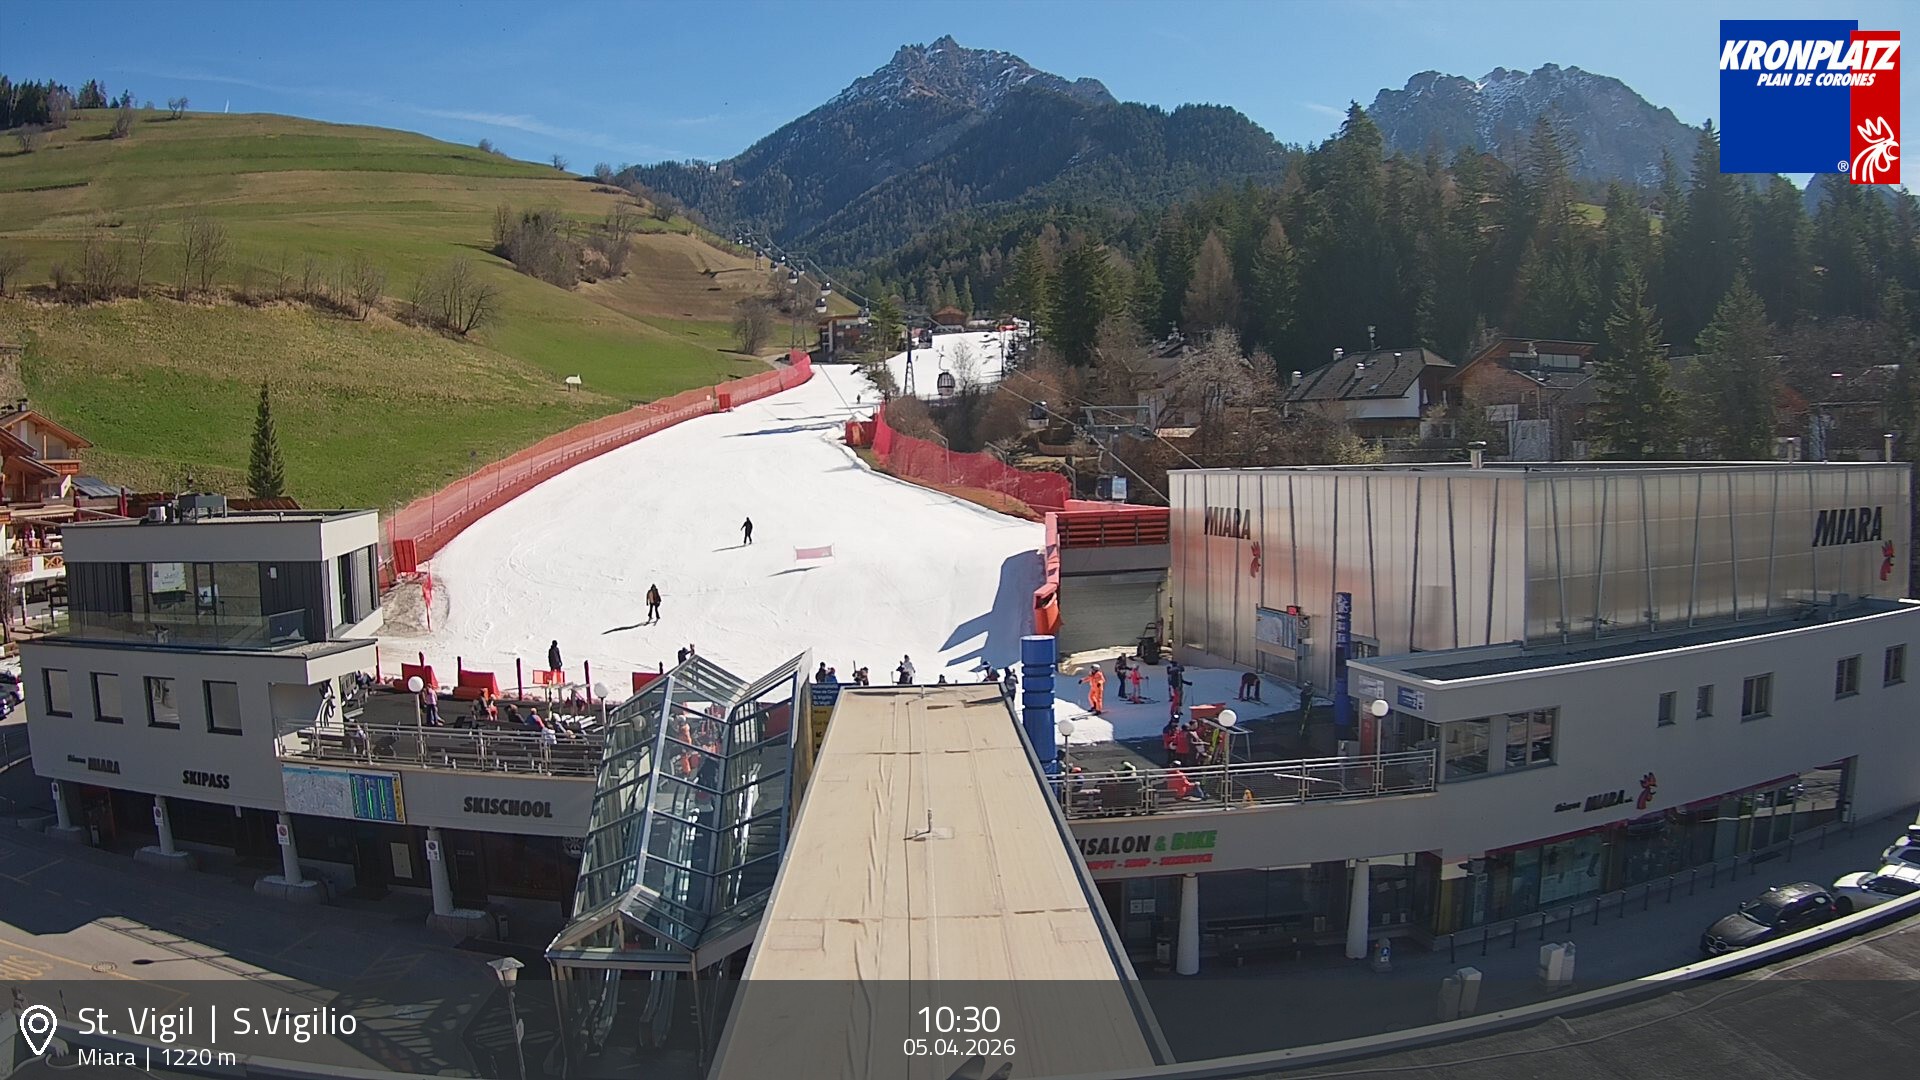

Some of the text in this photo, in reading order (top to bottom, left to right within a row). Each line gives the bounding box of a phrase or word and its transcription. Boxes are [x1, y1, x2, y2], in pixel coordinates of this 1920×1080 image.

[1204, 506, 1251, 540] MIARA
[1812, 506, 1882, 547] MIARA
[182, 769, 230, 789] SKIPASS
[463, 796, 553, 818] SKISCHOOL
[1170, 830, 1217, 851] BIKE
